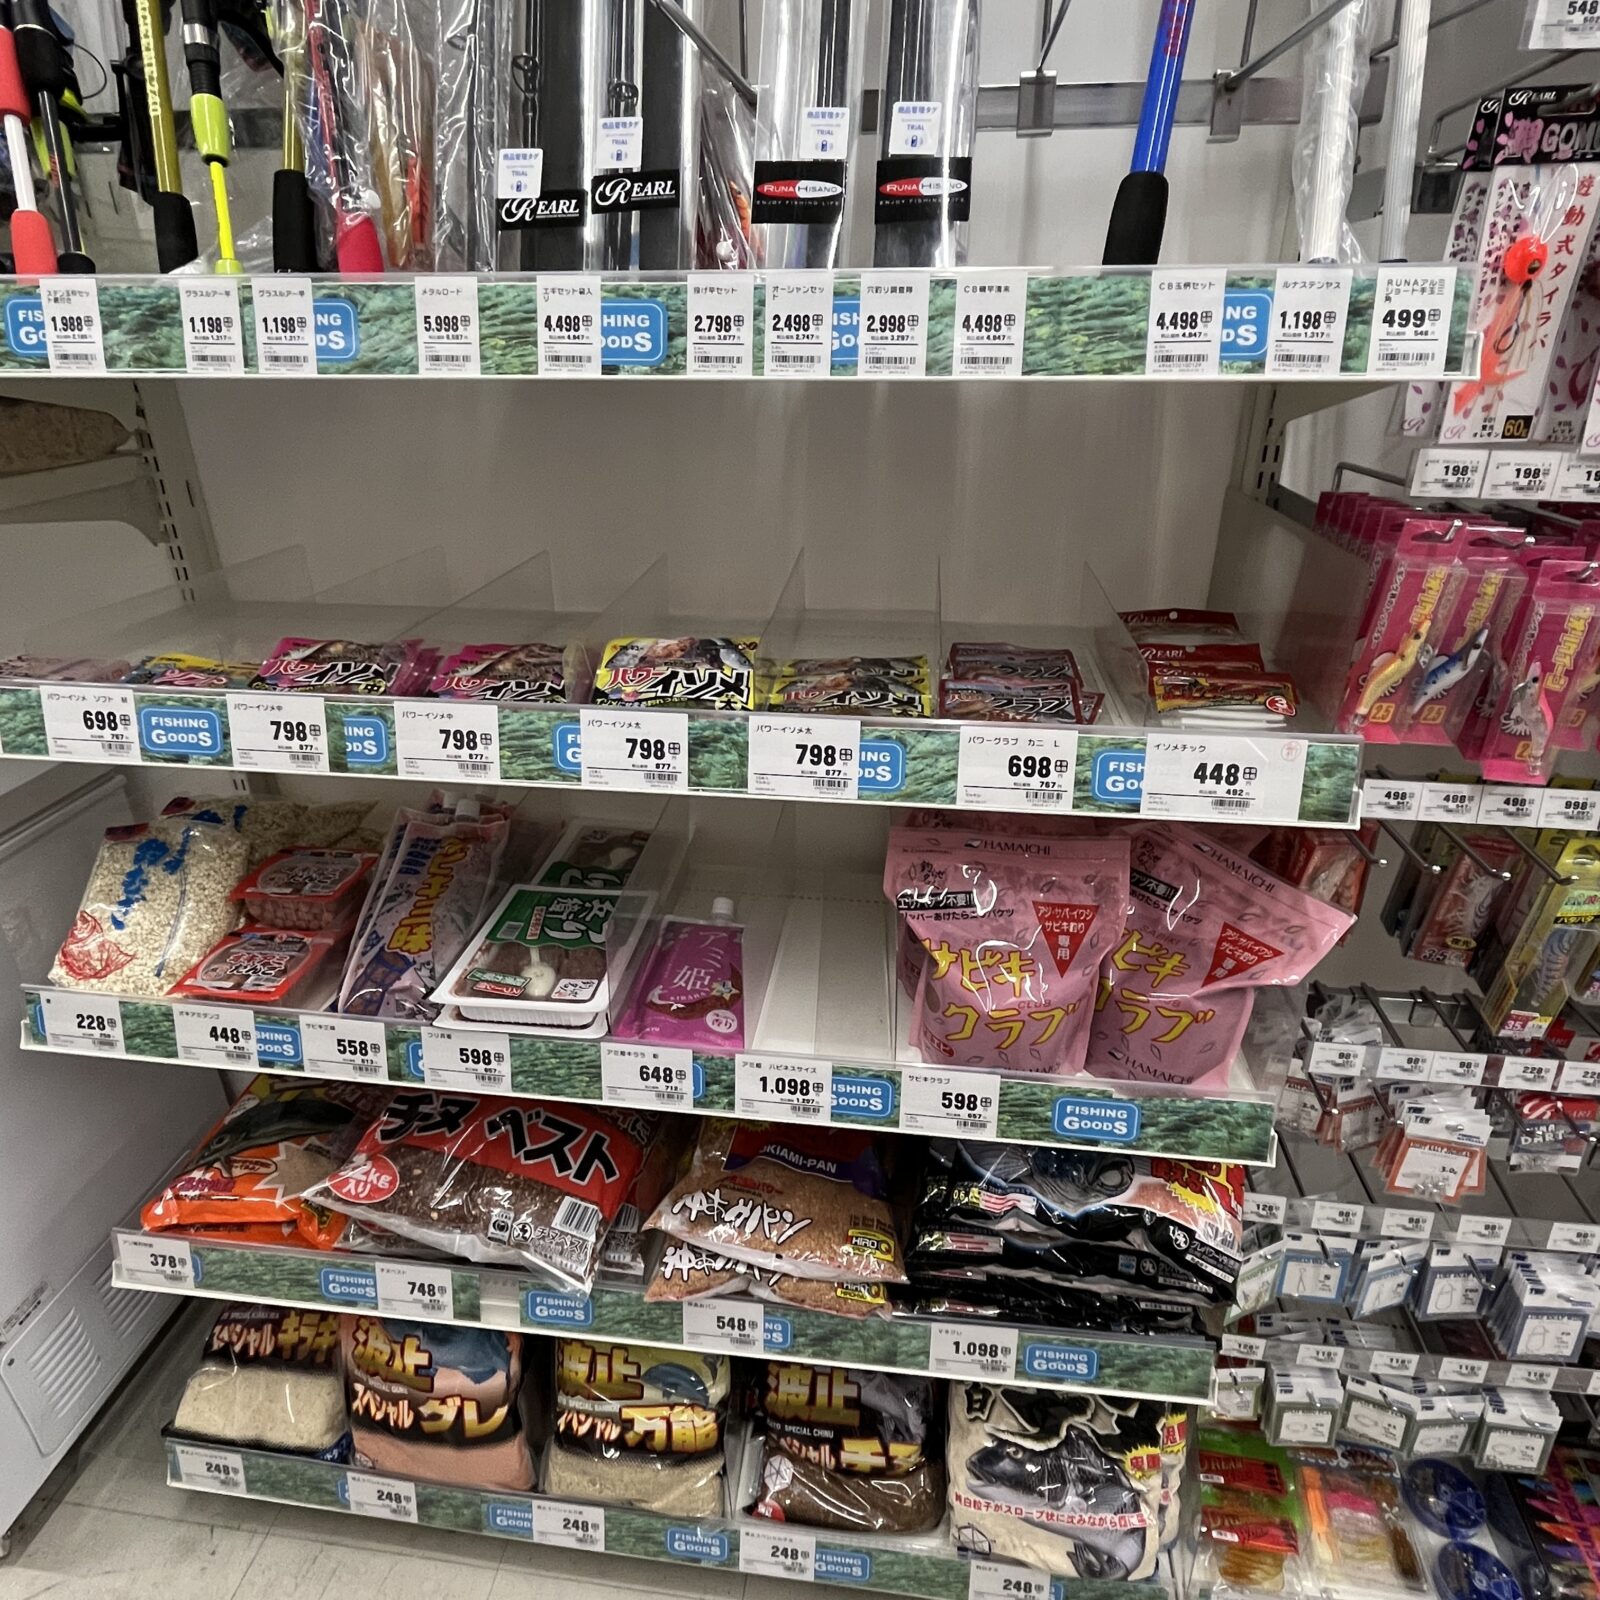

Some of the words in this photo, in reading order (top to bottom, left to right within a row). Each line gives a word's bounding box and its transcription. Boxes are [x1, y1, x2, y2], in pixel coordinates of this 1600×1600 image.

[1567, 0, 1599, 15] 548
[906, 123, 926, 131] TRIAL
[611, 138, 629, 146] TRIAL
[595, 177, 677, 207] REARL
[763, 185, 795, 194] RUNA
[797, 184, 839, 194] HISANO
[885, 182, 919, 193] RUNA
[1382, 308, 1427, 329] 499
[1443, 465, 1469, 476] 198
[1514, 467, 1541, 479] 198
[607, 667, 750, 703] パワーイソメ
[82, 710, 119, 731] 698
[151, 716, 209, 729] FISHING
[587, 719, 642, 730] パワーイソメ太
[270, 720, 308, 742] 798
[756, 724, 813, 735] パワーイソメ太
[151, 730, 212, 747] GOODS
[439, 728, 478, 751] 798
[968, 735, 1019, 747] パワーグラブ
[1027, 738, 1044, 747] カニ
[625, 737, 666, 761] 798
[795, 743, 837, 767] 798
[1008, 754, 1052, 779] 698
[1193, 762, 1240, 787] 448
[1384, 790, 1408, 801] 498
[1443, 794, 1467, 804] 498
[1503, 797, 1527, 807] 498
[1564, 800, 1588, 811] 998
[982, 839, 1051, 855] HAMAICHI
[1209, 848, 1275, 893] HAMAICHI
[671, 931, 728, 991] アミ姫
[921, 937, 1036, 998] サビキ
[76, 1013, 106, 1031] 228
[942, 1002, 1080, 1050] クラブ
[210, 1026, 240, 1044] 448
[336, 1038, 369, 1057] 558
[459, 1047, 492, 1066] 598
[639, 1065, 674, 1084] 648
[1522, 1066, 1543, 1075] 228
[941, 1091, 978, 1112] 598
[1066, 1105, 1128, 1119] FISHING
[1063, 1116, 1128, 1136] GOODS
[377, 1092, 620, 1184] チヌベスト
[150, 1253, 178, 1269] 378
[328, 1274, 374, 1286] FISHING
[407, 1281, 437, 1297] 748
[536, 1296, 584, 1309] FISHING
[535, 1306, 586, 1321] GOODS
[716, 1315, 747, 1332] 548
[213, 1323, 276, 1357] スペシャル
[1035, 1349, 1088, 1362] FISHING
[1033, 1358, 1089, 1375] GOODS
[352, 1382, 414, 1430] スペシャル
[419, 1395, 508, 1439] グレ
[784, 1425, 812, 1437] SPECIAL
[812, 1428, 834, 1439] CHINU
[205, 1461, 231, 1476] 248
[376, 1489, 402, 1505] 248
[562, 1517, 590, 1533] 248
[770, 1545, 799, 1561] 248
[815, 1553, 862, 1566] FISHING
[1002, 1578, 1034, 1595] 248
